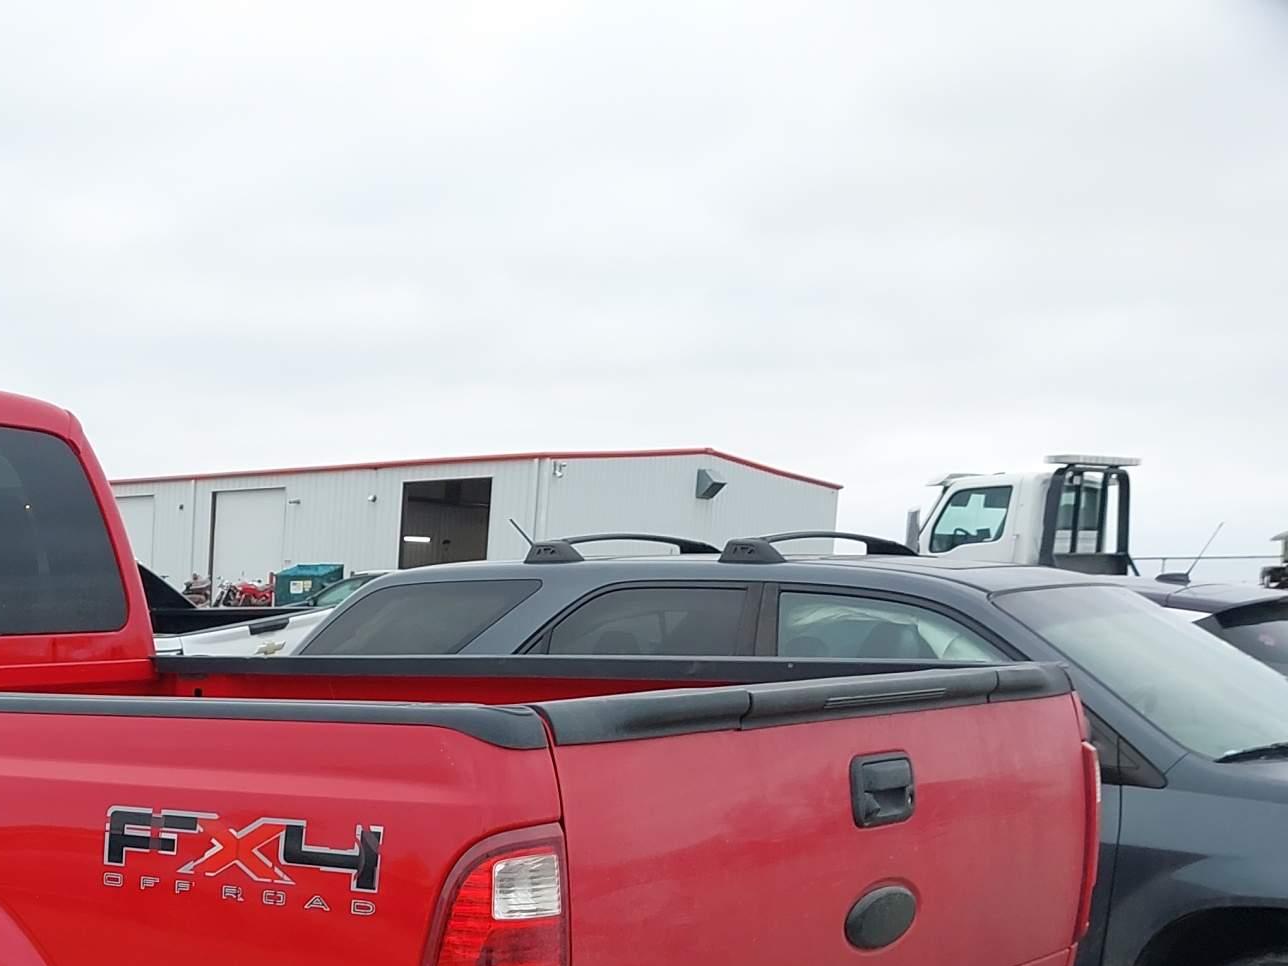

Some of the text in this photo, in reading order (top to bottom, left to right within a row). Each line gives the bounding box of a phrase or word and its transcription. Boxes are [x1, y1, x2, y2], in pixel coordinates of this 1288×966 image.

[103, 805, 384, 893] FX4
[103, 872, 376, 916] OFF ROAD
